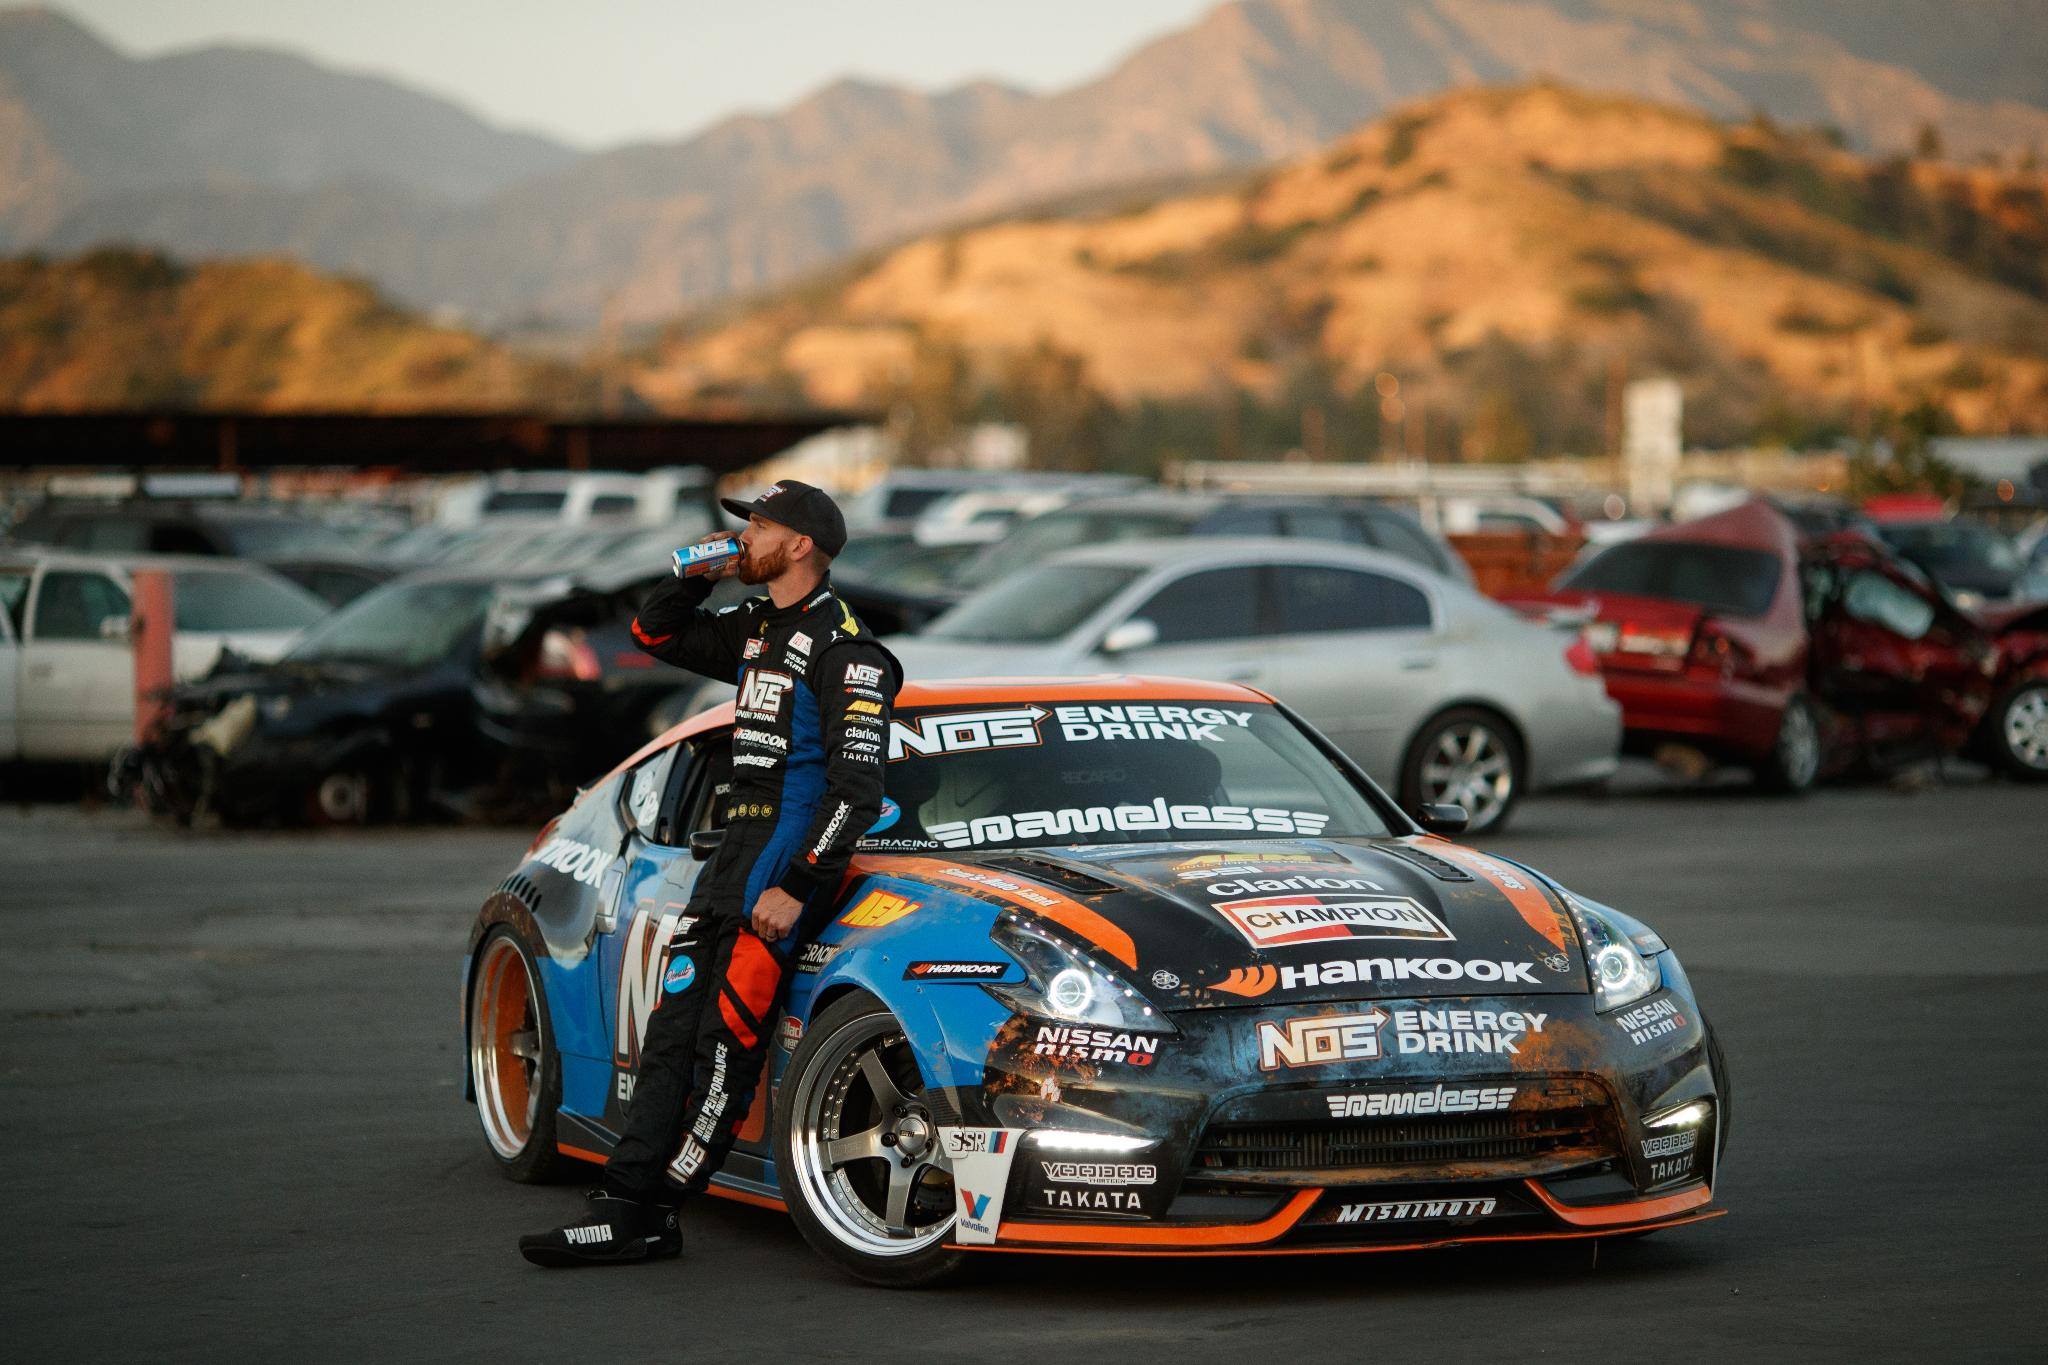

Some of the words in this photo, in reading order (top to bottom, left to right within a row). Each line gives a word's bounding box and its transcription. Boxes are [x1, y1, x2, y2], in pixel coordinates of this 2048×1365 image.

[689, 539, 728, 561] NOS
[844, 663, 884, 684] NOS
[846, 700, 883, 715] AEM
[1054, 706, 1254, 728] ENERGY
[845, 727, 880, 743] clarion
[887, 703, 1052, 762] NOS
[1062, 723, 1226, 742] DRINK
[842, 752, 879, 765] TAKATA
[969, 798, 1298, 846] nameless
[880, 840, 938, 848] RACING
[839, 889, 921, 927] AEM
[1246, 907, 1421, 929] CHAMPION
[1395, 1011, 1547, 1032] ENERGY
[1616, 999, 1678, 1032] NISSAN
[1036, 1026, 1158, 1054] NISSAN
[1259, 1008, 1391, 1068] NOS
[1630, 1014, 1687, 1046] nismo
[1034, 1042, 1153, 1065] nismo
[1400, 1031, 1520, 1054] DRINK
[949, 1131, 985, 1152] SSR
[1041, 1162, 1156, 1179] VOODOO
[1650, 1153, 1694, 1180] TAKATA
[1043, 1189, 1141, 1209] TAKATA
[1337, 1198, 1496, 1223] MISHIMOTO
[564, 1224, 613, 1244] PUMA
[960, 1218, 989, 1234] Valvoline
